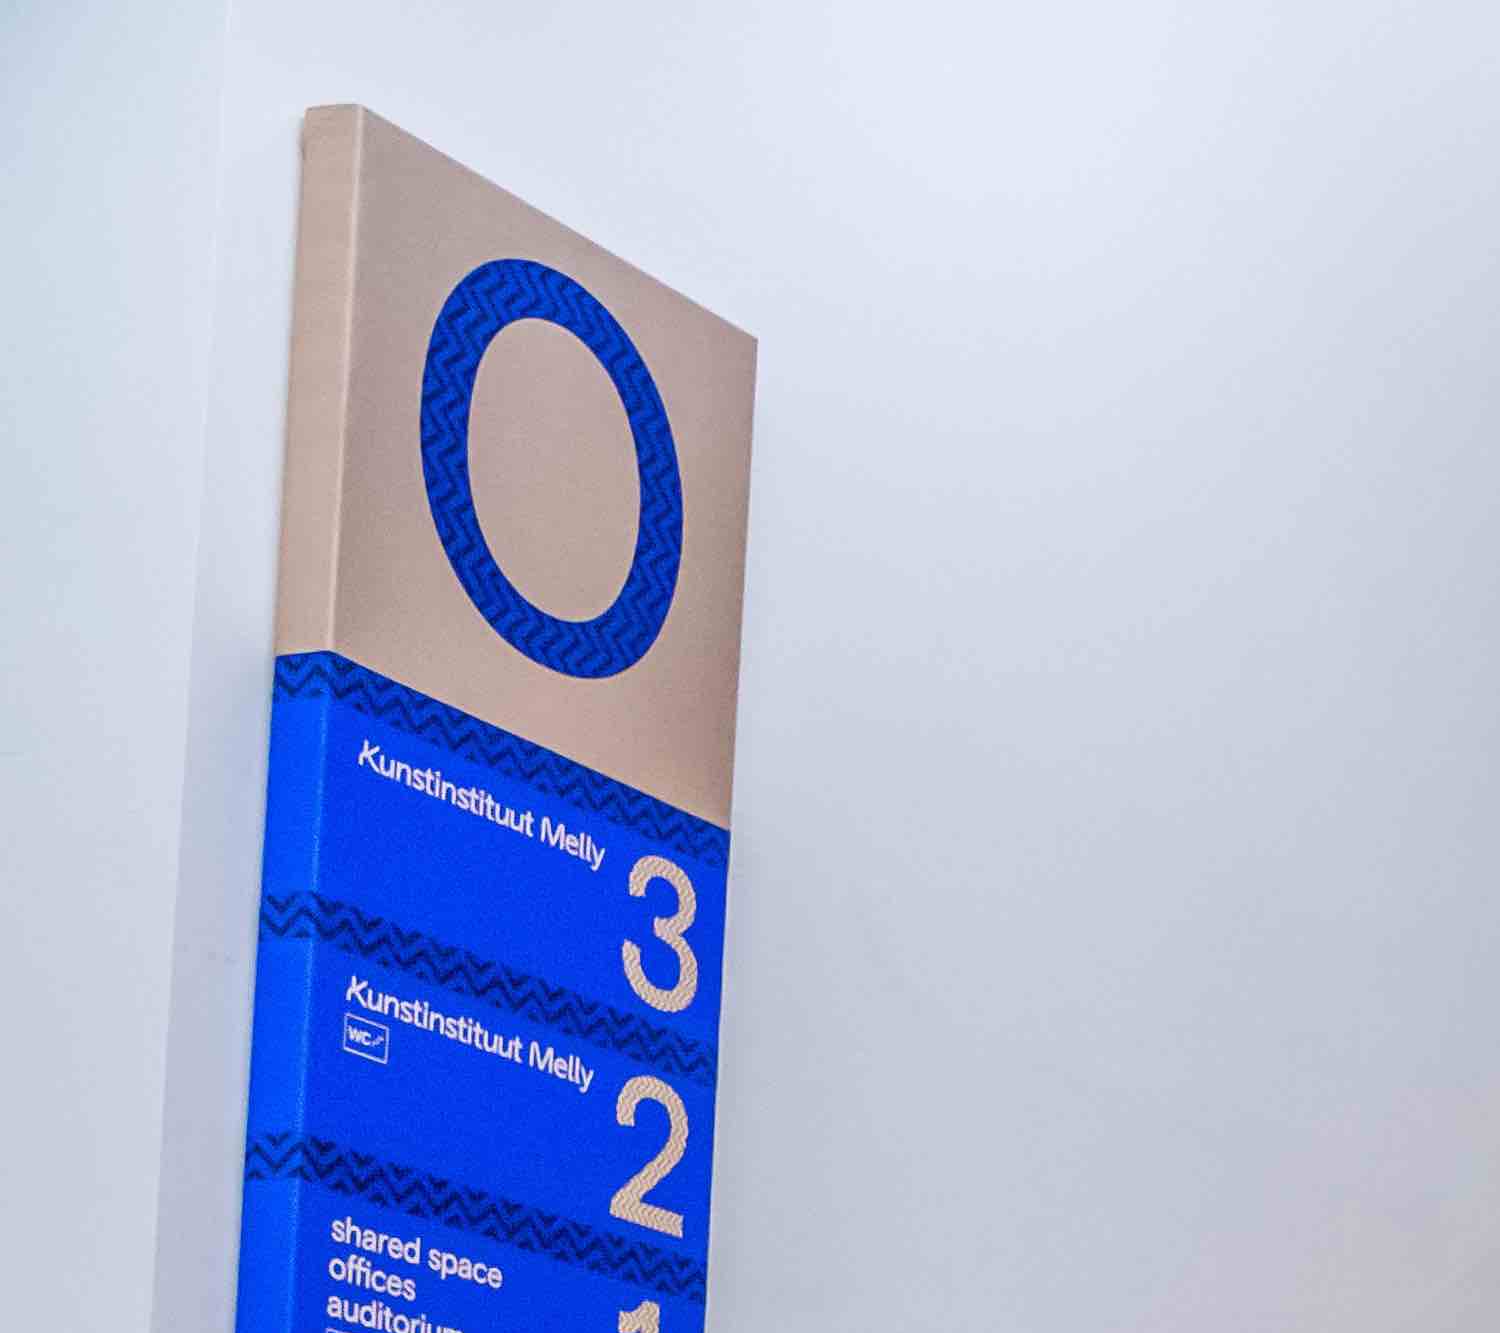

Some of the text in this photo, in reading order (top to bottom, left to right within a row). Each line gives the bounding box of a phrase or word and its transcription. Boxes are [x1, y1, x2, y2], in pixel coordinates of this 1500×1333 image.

[358, 739, 606, 872] Kunstinstituut Melly
[622, 855, 698, 1012] 3
[346, 976, 594, 1093] Kunstinstituut Melly
[346, 1026, 371, 1046] WC
[610, 1075, 689, 1238] 2
[329, 1254, 416, 1301] offices
[331, 1217, 503, 1288] shared space
